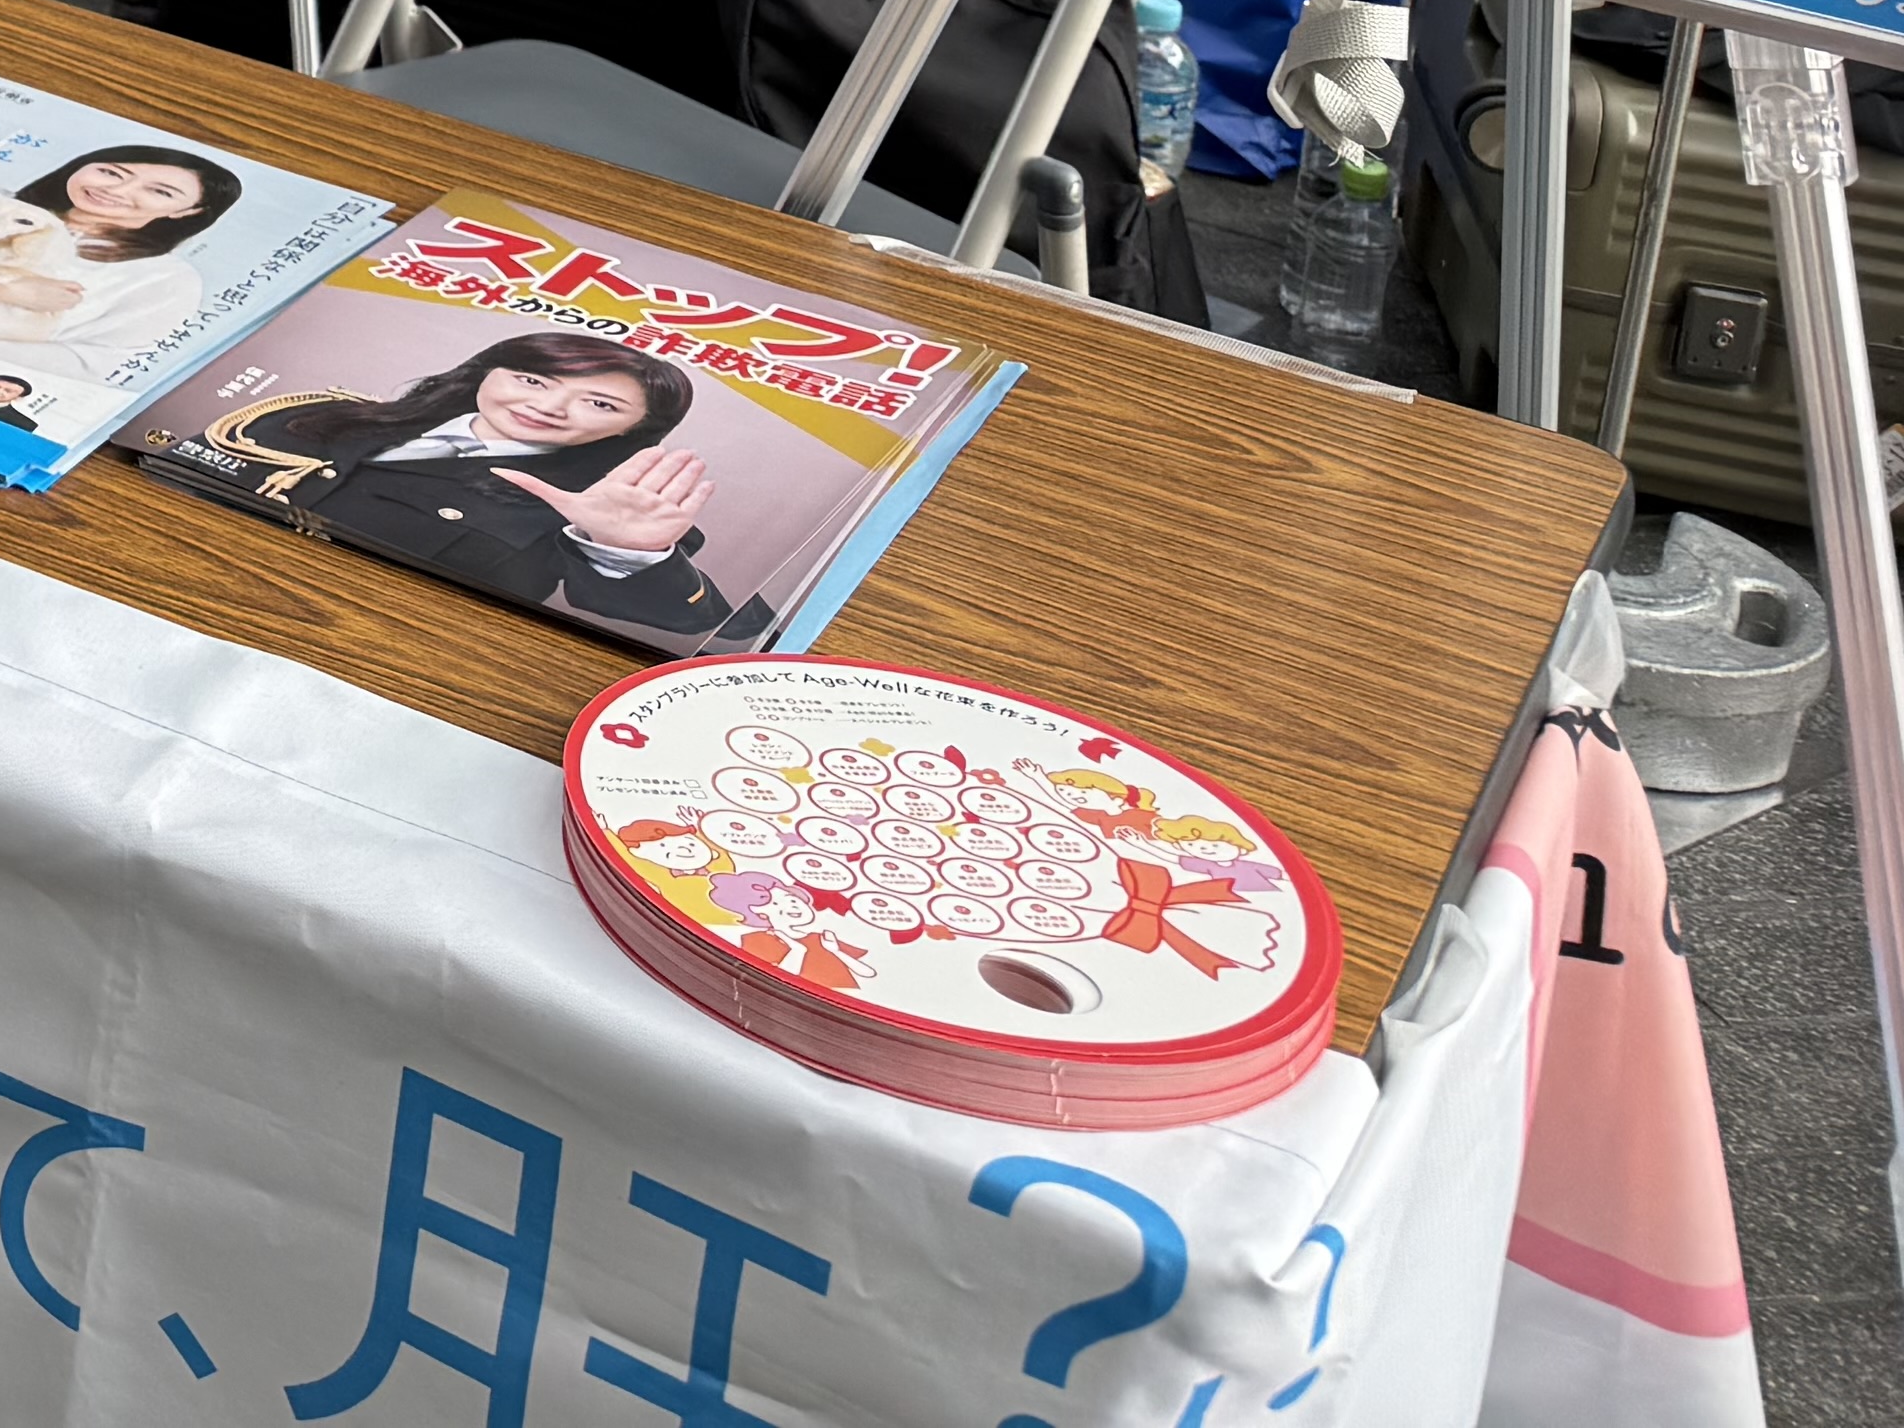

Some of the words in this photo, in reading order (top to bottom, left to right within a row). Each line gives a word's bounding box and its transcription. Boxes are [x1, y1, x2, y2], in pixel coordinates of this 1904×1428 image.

[369, 251, 920, 422] 海外からの詐欺電話
[414, 214, 964, 391] ストップ!
[628, 671, 796, 724] スタンプラリーに参加して
[802, 672, 910, 695] Age-Well
